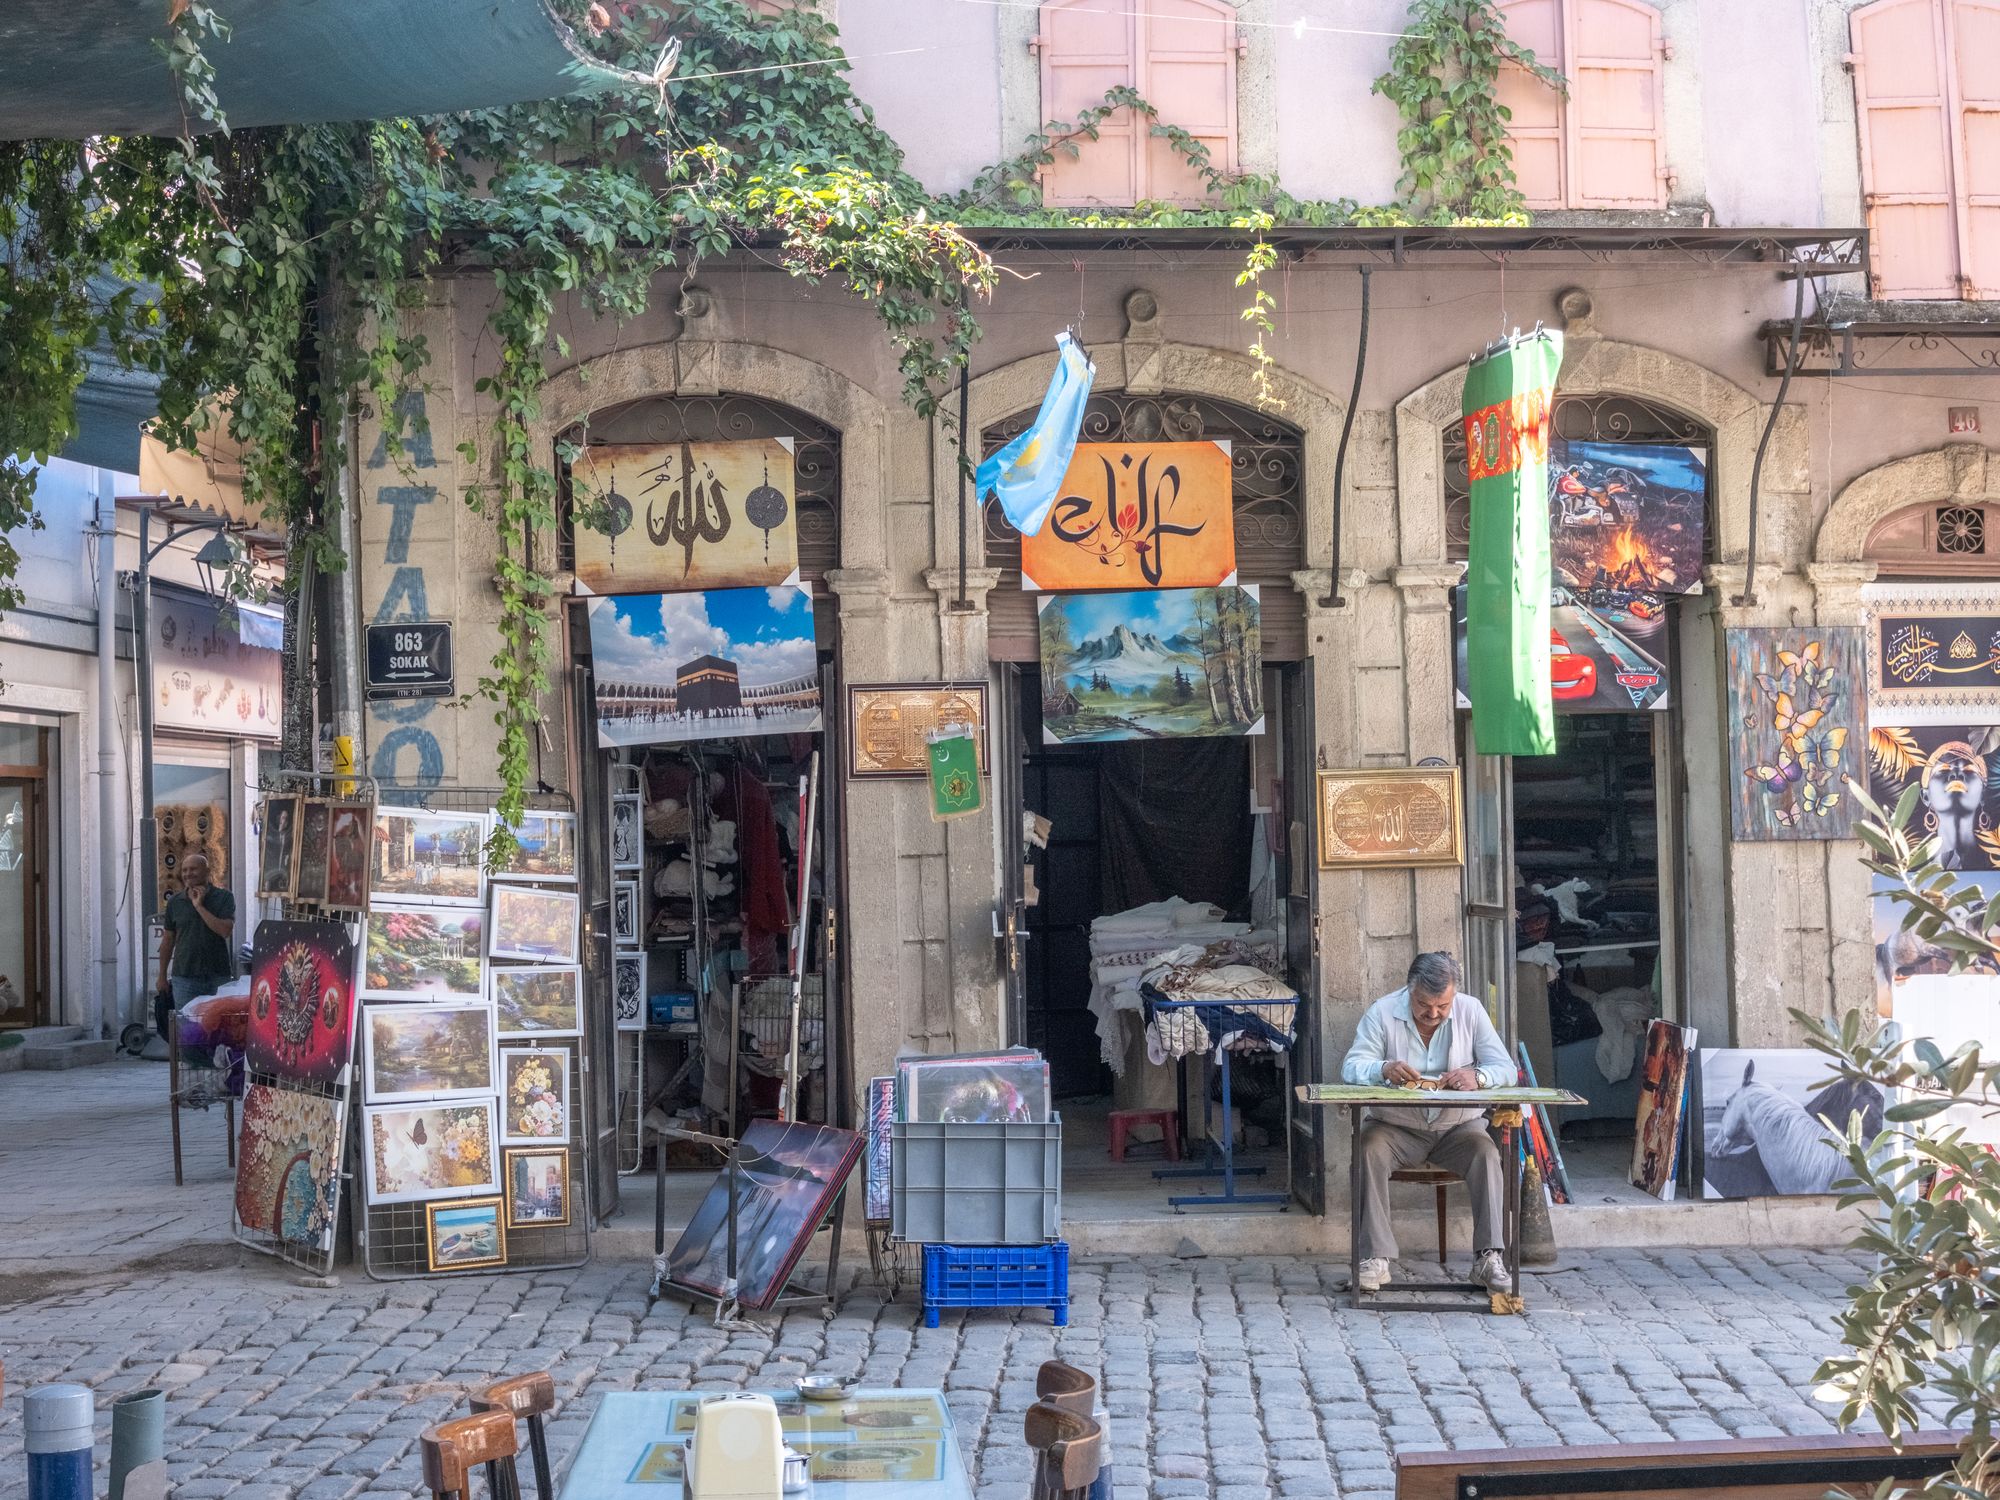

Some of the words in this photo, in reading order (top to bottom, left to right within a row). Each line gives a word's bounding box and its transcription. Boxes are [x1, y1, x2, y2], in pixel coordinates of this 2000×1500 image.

[1954, 411, 1977, 432] 46
[394, 631, 424, 652] 863
[389, 655, 430, 669] SOKAK
